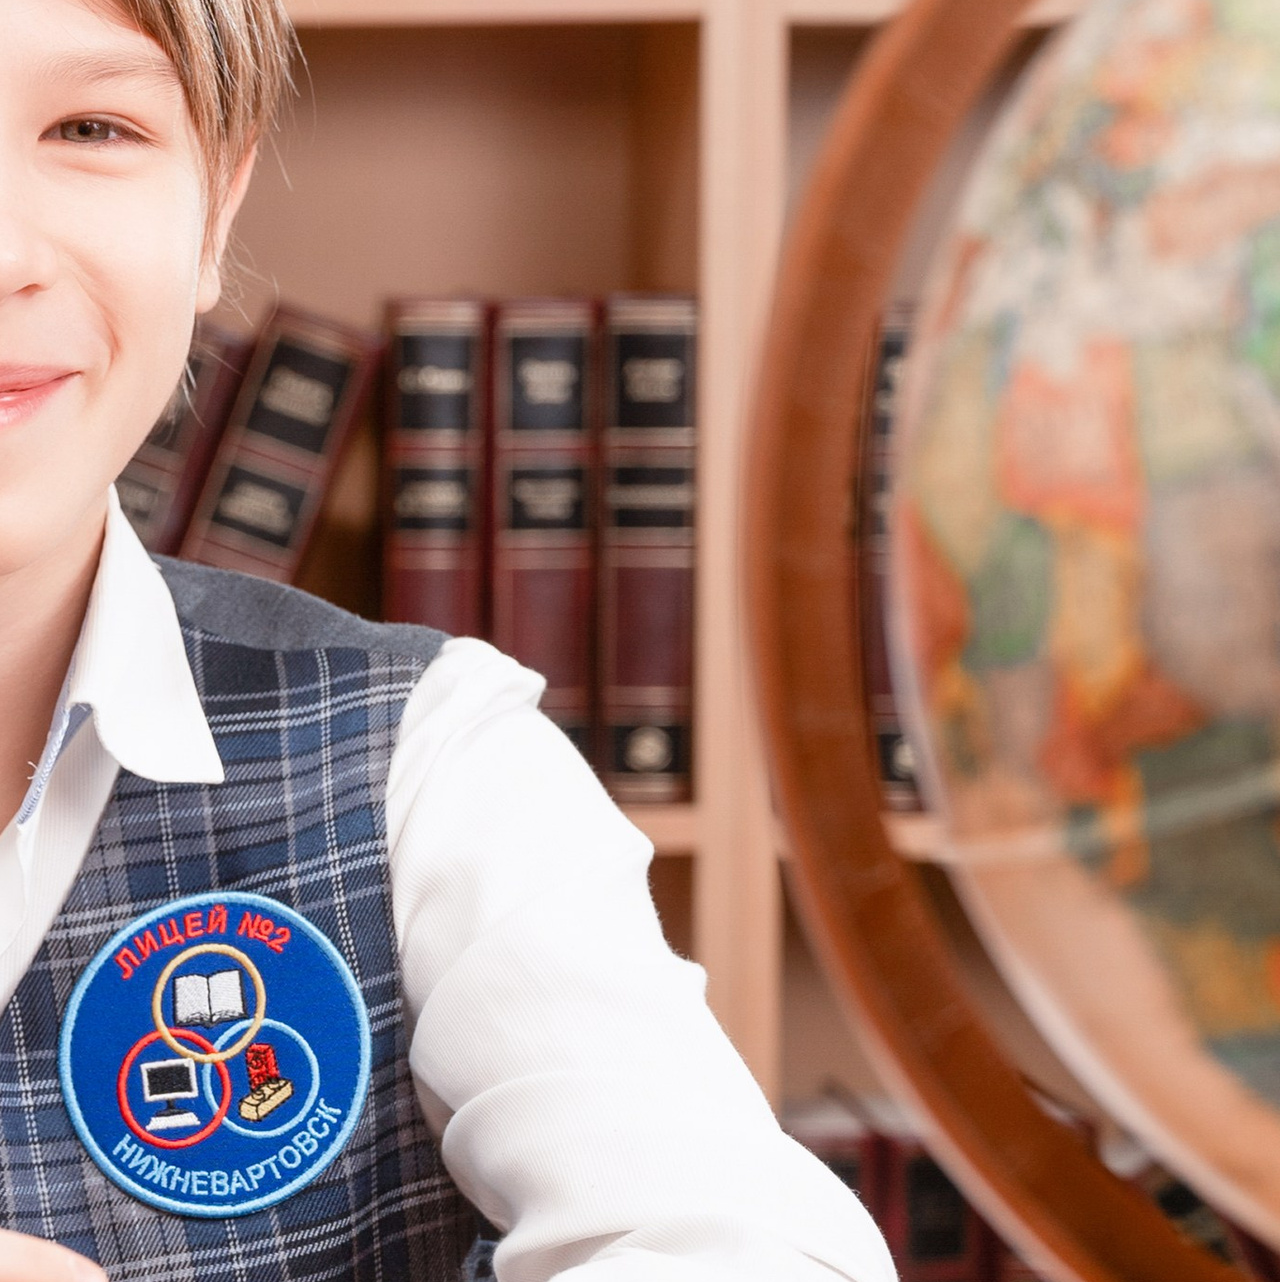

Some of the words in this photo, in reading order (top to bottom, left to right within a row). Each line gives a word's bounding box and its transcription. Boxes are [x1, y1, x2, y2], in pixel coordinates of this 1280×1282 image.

[114, 904, 228, 980] ЛИЦЕЙ
[237, 911, 291, 953] №2
[112, 1097, 342, 1196] НИЖНЕВАРТОВСК
